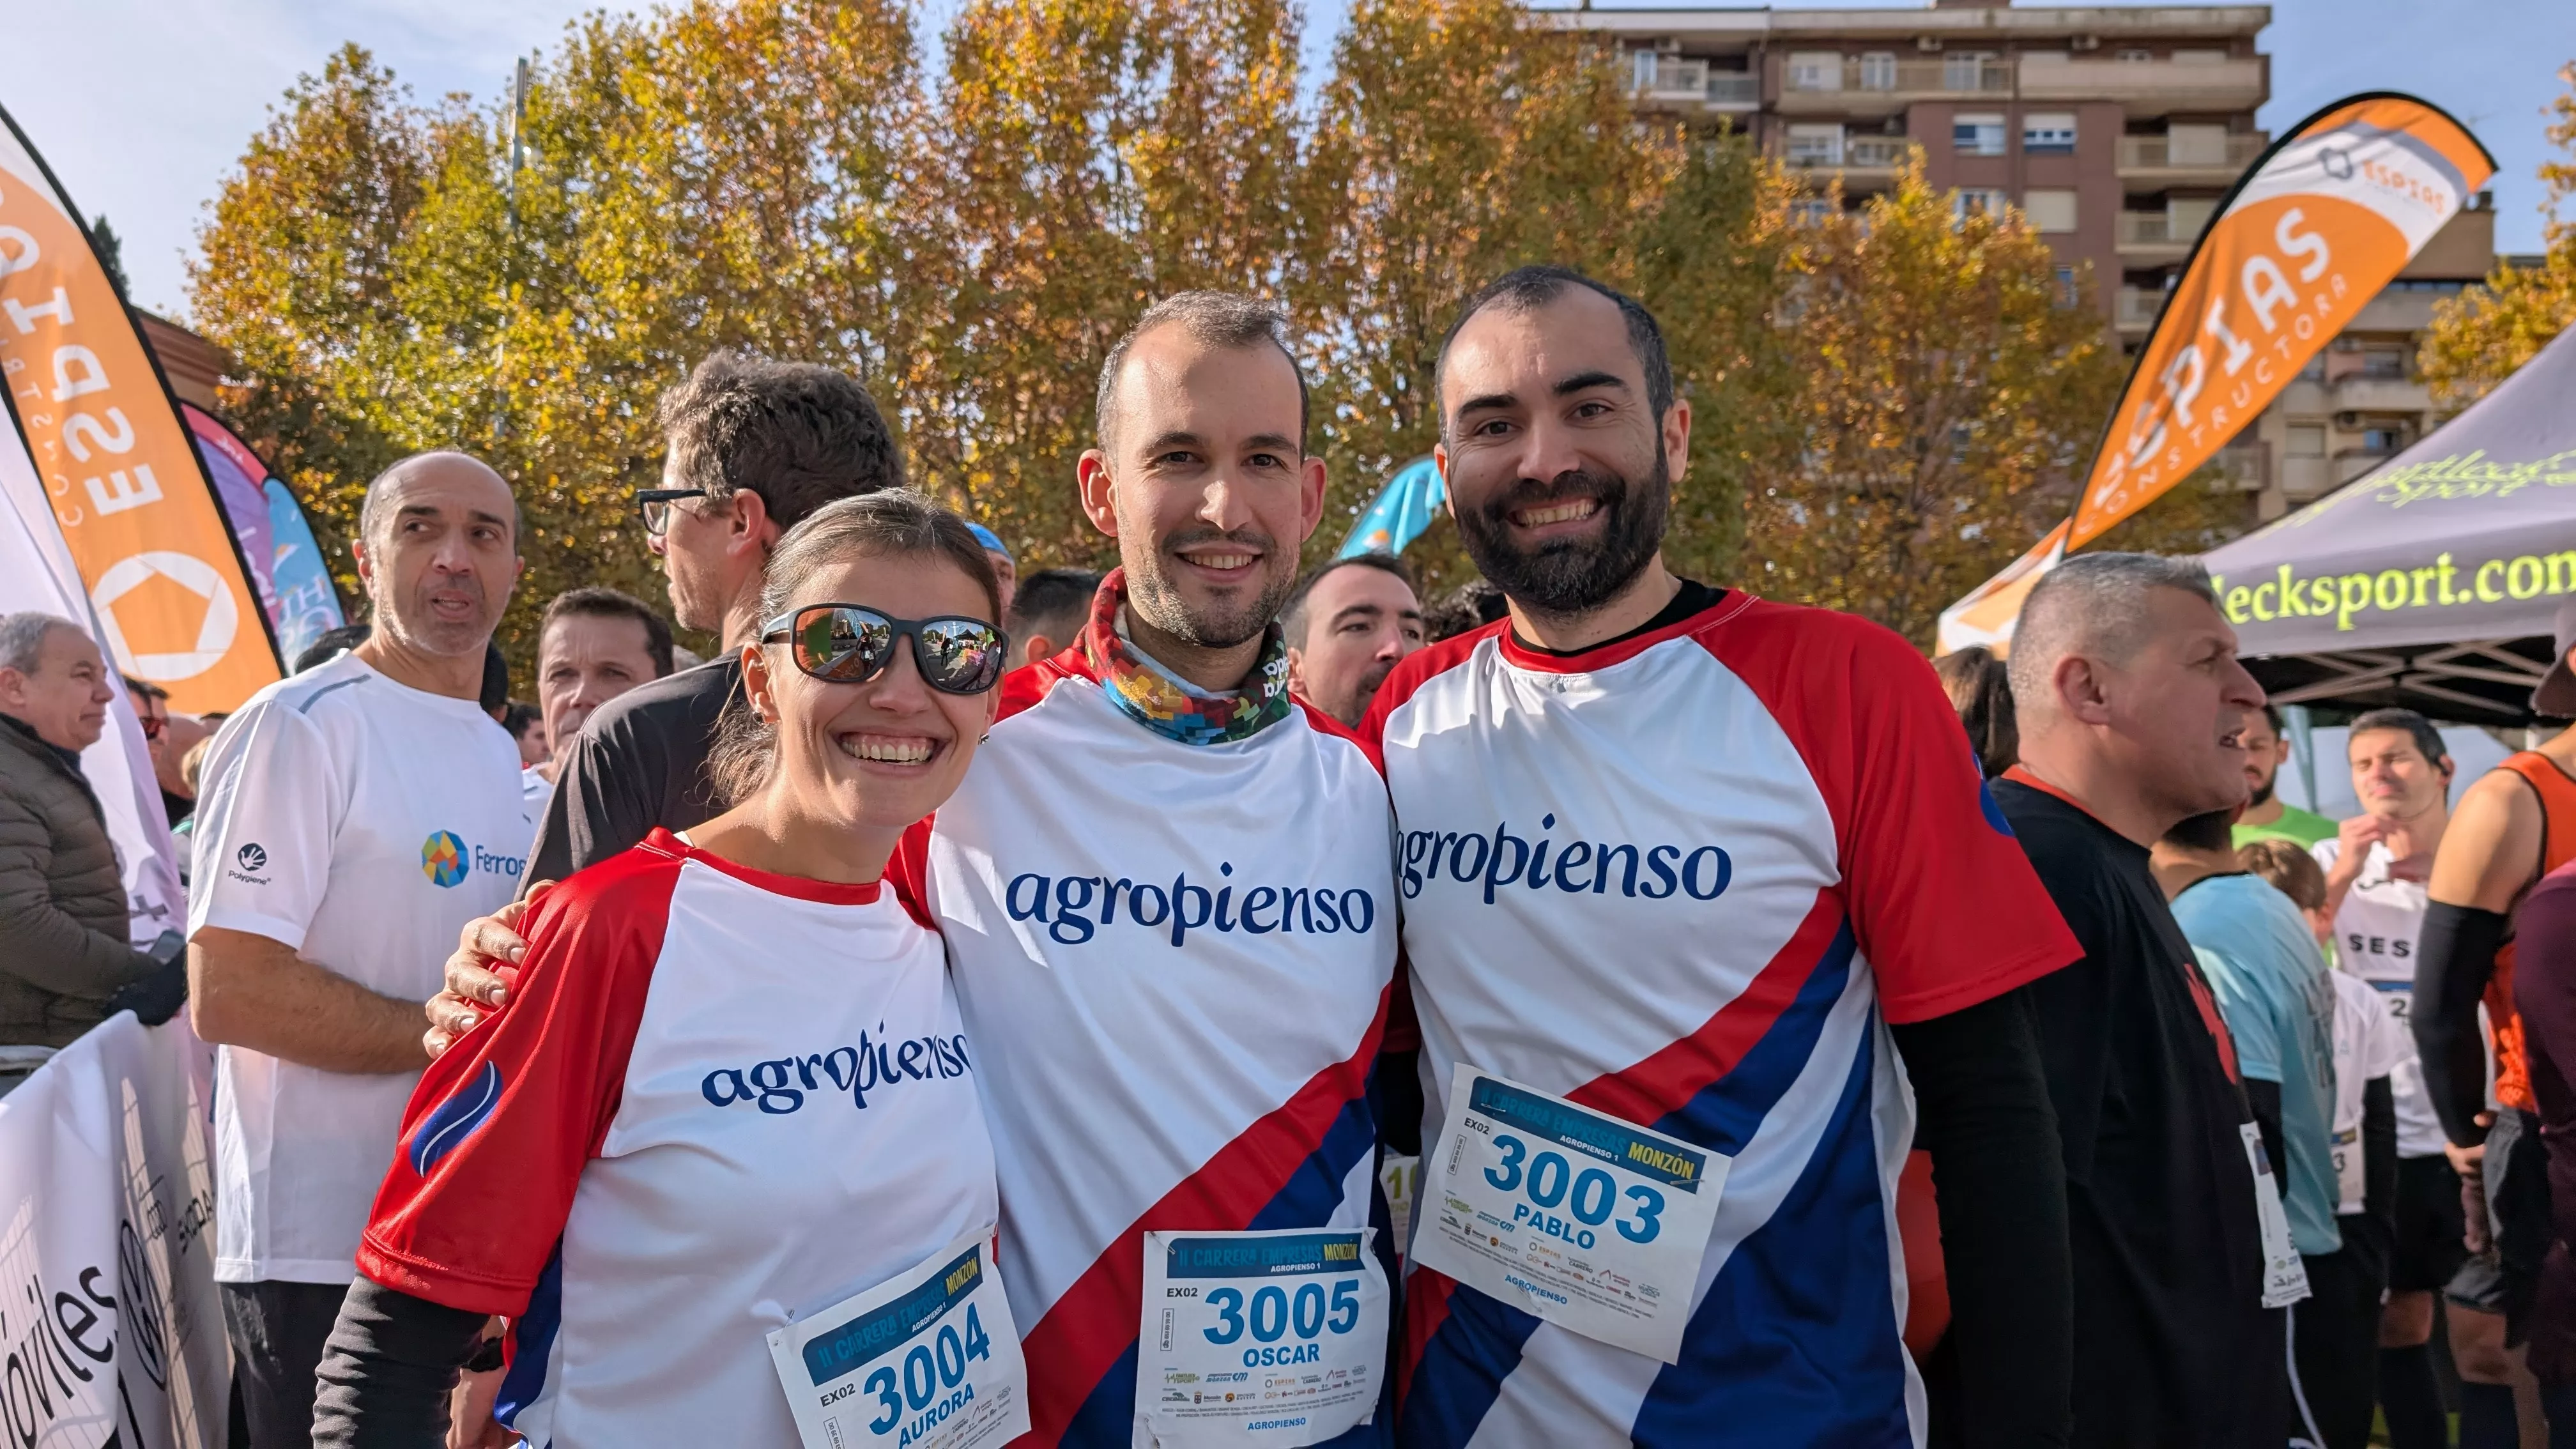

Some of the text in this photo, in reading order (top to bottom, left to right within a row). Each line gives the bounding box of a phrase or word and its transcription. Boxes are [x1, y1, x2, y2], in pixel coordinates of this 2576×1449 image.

[1006, 861, 1374, 947] agropienso
[1464, 1117, 1489, 1135] EX02
[1492, 1093, 1549, 1128] CARRERA
[1552, 1116, 1627, 1155] EMPRESAS
[1628, 1142, 1695, 1179] MONZÓN
[1560, 1135, 1612, 1159] AGROPIENSO
[1483, 1134, 1666, 1244] 3003
[1514, 1202, 1595, 1250] PABLO
[1193, 1248, 1257, 1267] CARRERA
[1261, 1245, 1322, 1266] EMPRESAS
[1323, 1239, 1358, 1262] MONZÓN
[1270, 1264, 1315, 1273] AGROPIENSO
[1167, 1287, 1198, 1298] EX02
[1505, 1274, 1568, 1305] AGROPIENSO
[836, 1315, 897, 1363] CARRERA
[900, 1281, 946, 1330] EMPRESAS
[946, 1256, 977, 1296] MONZÓN
[912, 1305, 943, 1333] AGROPIENSO
[1203, 1279, 1360, 1345] 3005
[864, 1301, 990, 1436] 3004
[1243, 1344, 1320, 1367] OSCAR
[820, 1383, 855, 1407] EX02
[899, 1383, 974, 1449] AURORA
[1248, 1416, 1307, 1430] AGROPIENSO
